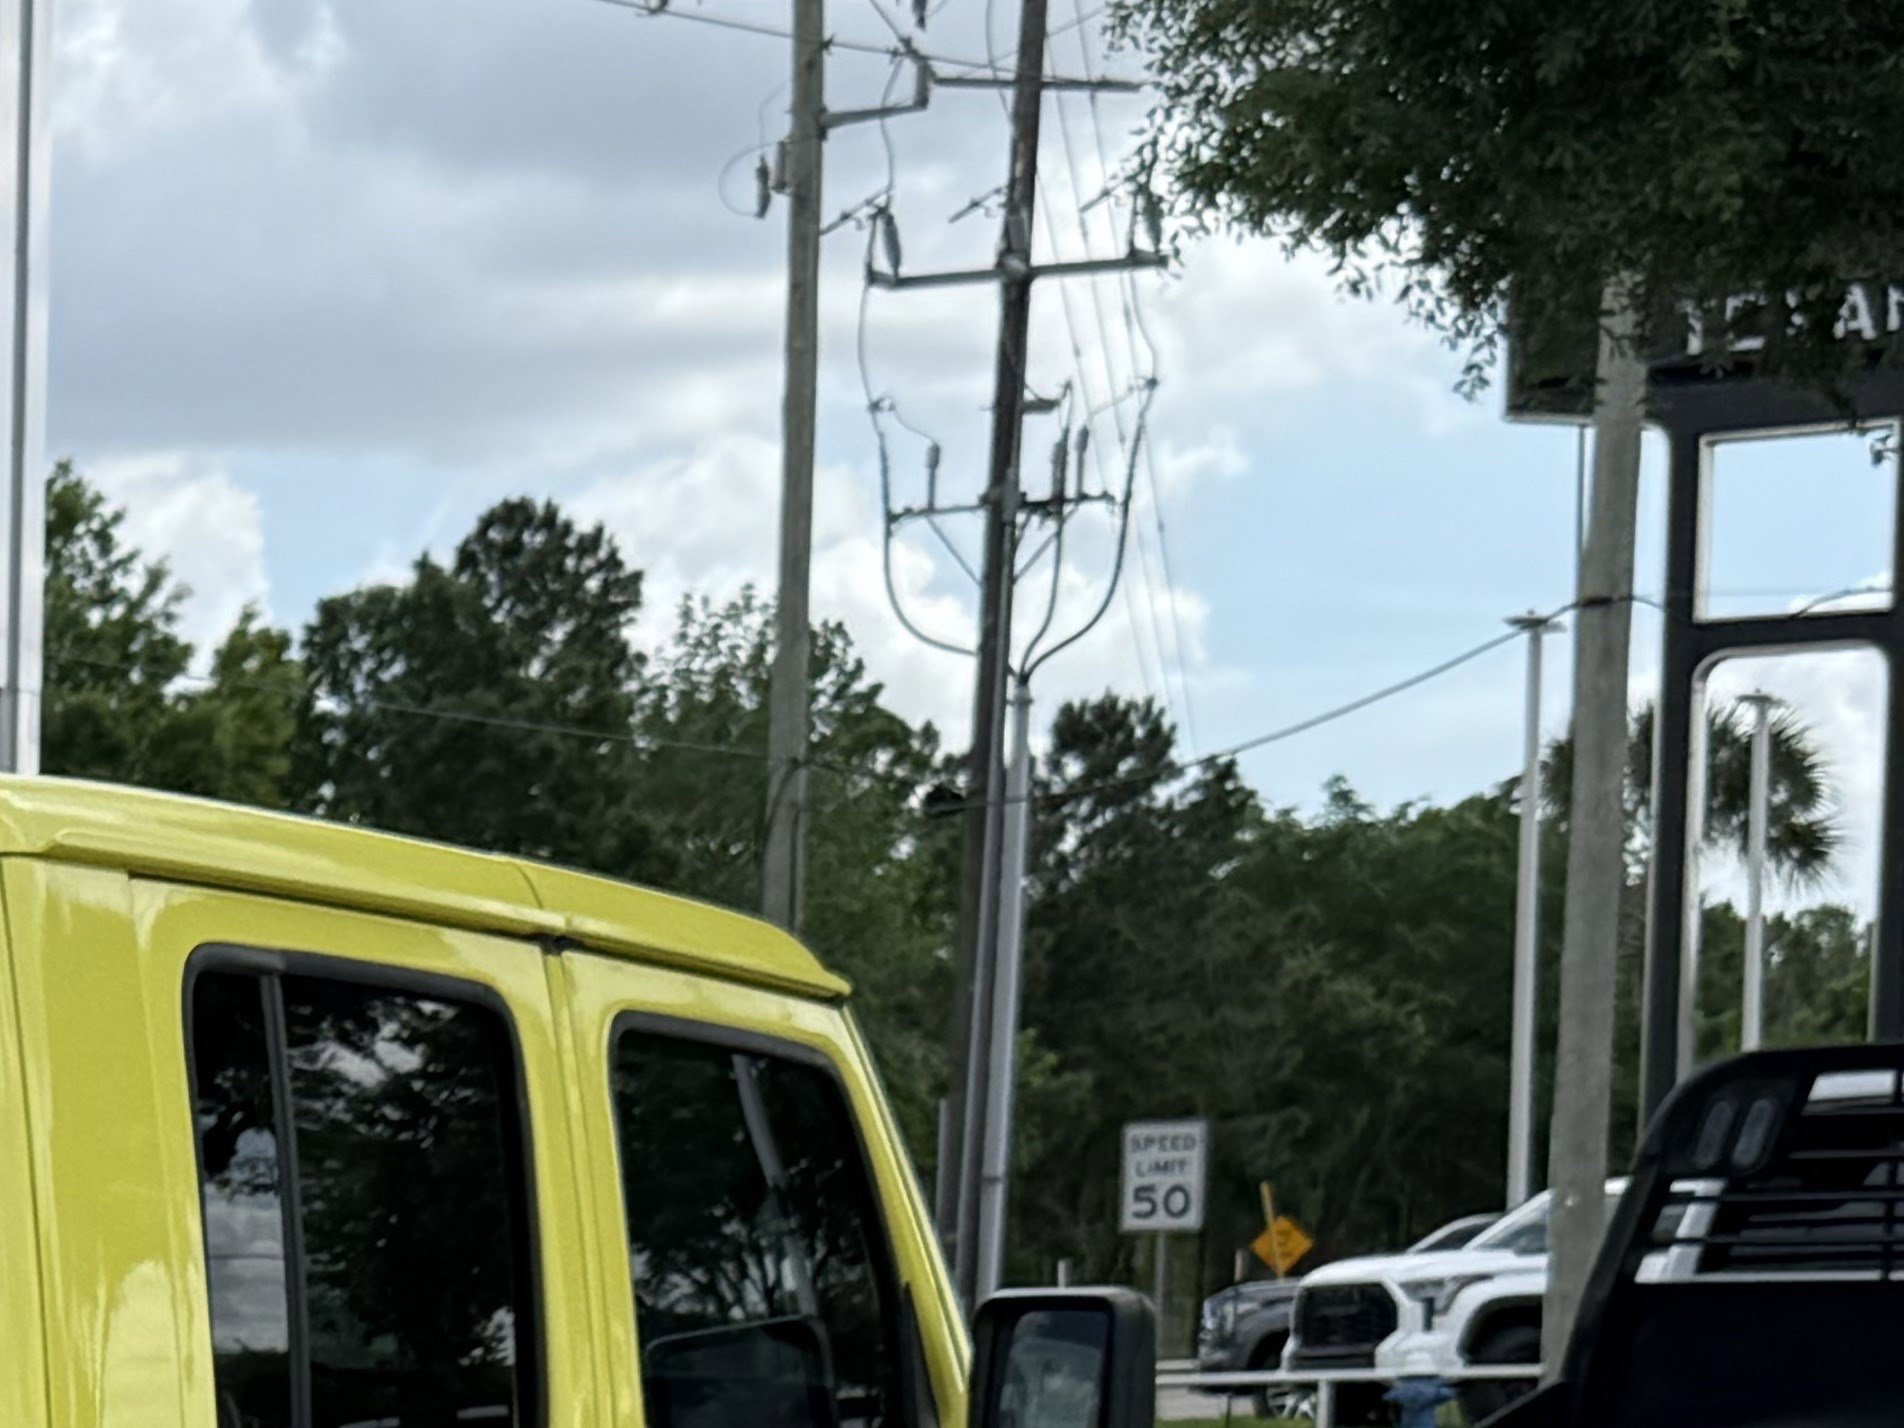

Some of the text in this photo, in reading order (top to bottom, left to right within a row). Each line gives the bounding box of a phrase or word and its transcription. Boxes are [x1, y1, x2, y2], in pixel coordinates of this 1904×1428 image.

[1130, 1134, 1197, 1153] SPEED
[1135, 1158, 1188, 1177] LIMIT
[1131, 1185, 1191, 1219] 50
